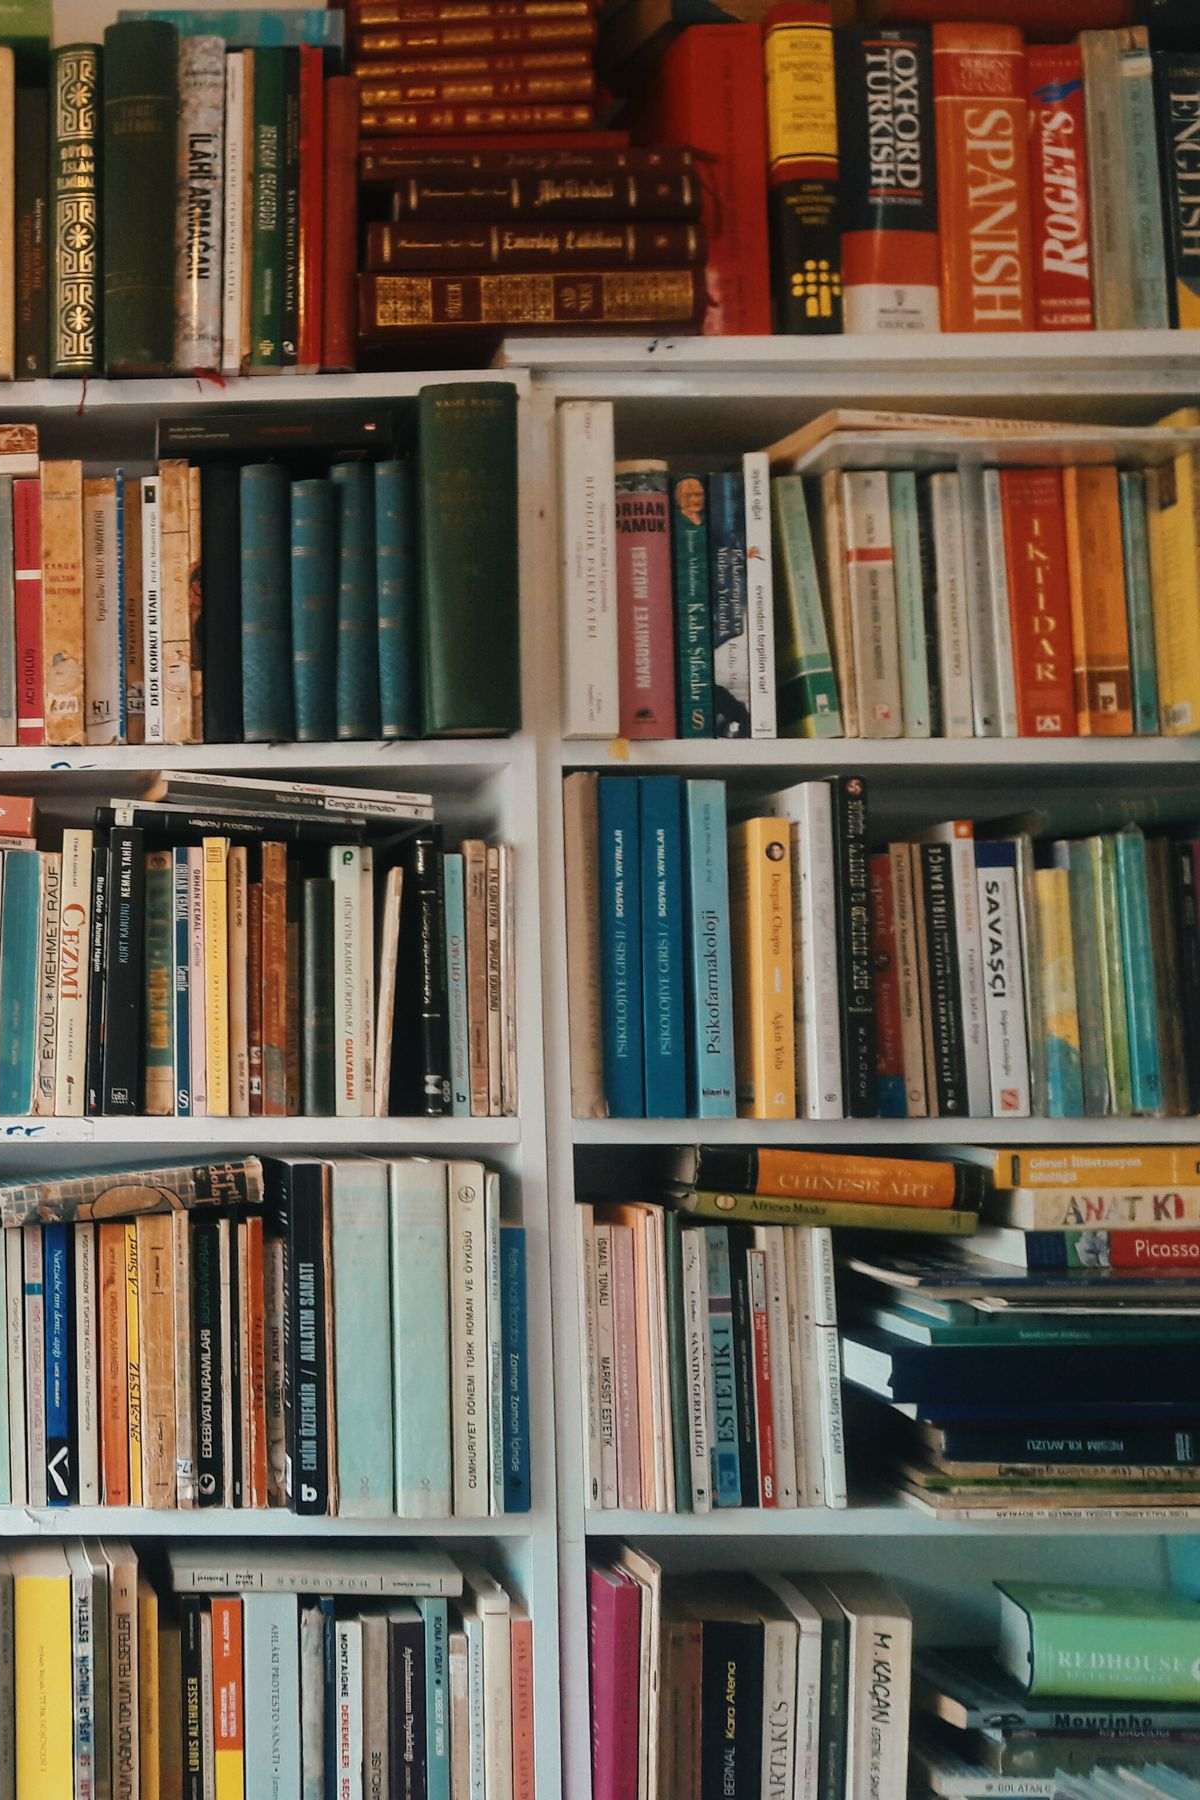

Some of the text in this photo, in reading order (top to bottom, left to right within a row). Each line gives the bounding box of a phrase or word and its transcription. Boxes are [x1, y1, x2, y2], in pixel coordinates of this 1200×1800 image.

[865, 49, 897, 189] TURKISH
[897, 48, 922, 190] OXFORD
[963, 108, 1023, 323] SPANISH
[633, 606, 651, 688] MASUMİYET
[689, 603, 708, 642] Kadın
[147, 590, 159, 706] DEDE KORKUT KİTABI
[613, 830, 623, 879] YAYINLAR
[656, 829, 666, 877] YAYINLAR
[96, 876, 104, 892] Bize
[121, 872, 131, 897] KEMAL
[44, 866, 59, 988] MEHMET RAUF
[95, 922, 103, 946] Ahmet
[986, 880, 1006, 999] SAVAŞÇI
[702, 909, 722, 1055] Psikofarmakoloji
[344, 1038, 356, 1101] GULYABANİ
[774, 1046, 785, 1071] Yolu
[776, 1175, 936, 1198] CHINESE ART
[1135, 1240, 1200, 1257] Picasso
[298, 1263, 314, 1306] SANATI
[465, 1279, 474, 1292] VE
[299, 1309, 315, 1362] ANLATIM
[465, 1298, 475, 1335] ROMAN
[466, 1342, 475, 1368] TÜRK
[199, 1329, 213, 1458] EDEBİYAT KURAMLARI
[712, 1345, 735, 1443] ESTETİK
[300, 1440, 316, 1471] EMİN
[467, 1421, 477, 1489] CUMHURİYET
[1057, 1650, 1186, 1673] REDHOUSE
[270, 1667, 281, 1764] PROTESTO SANATI
